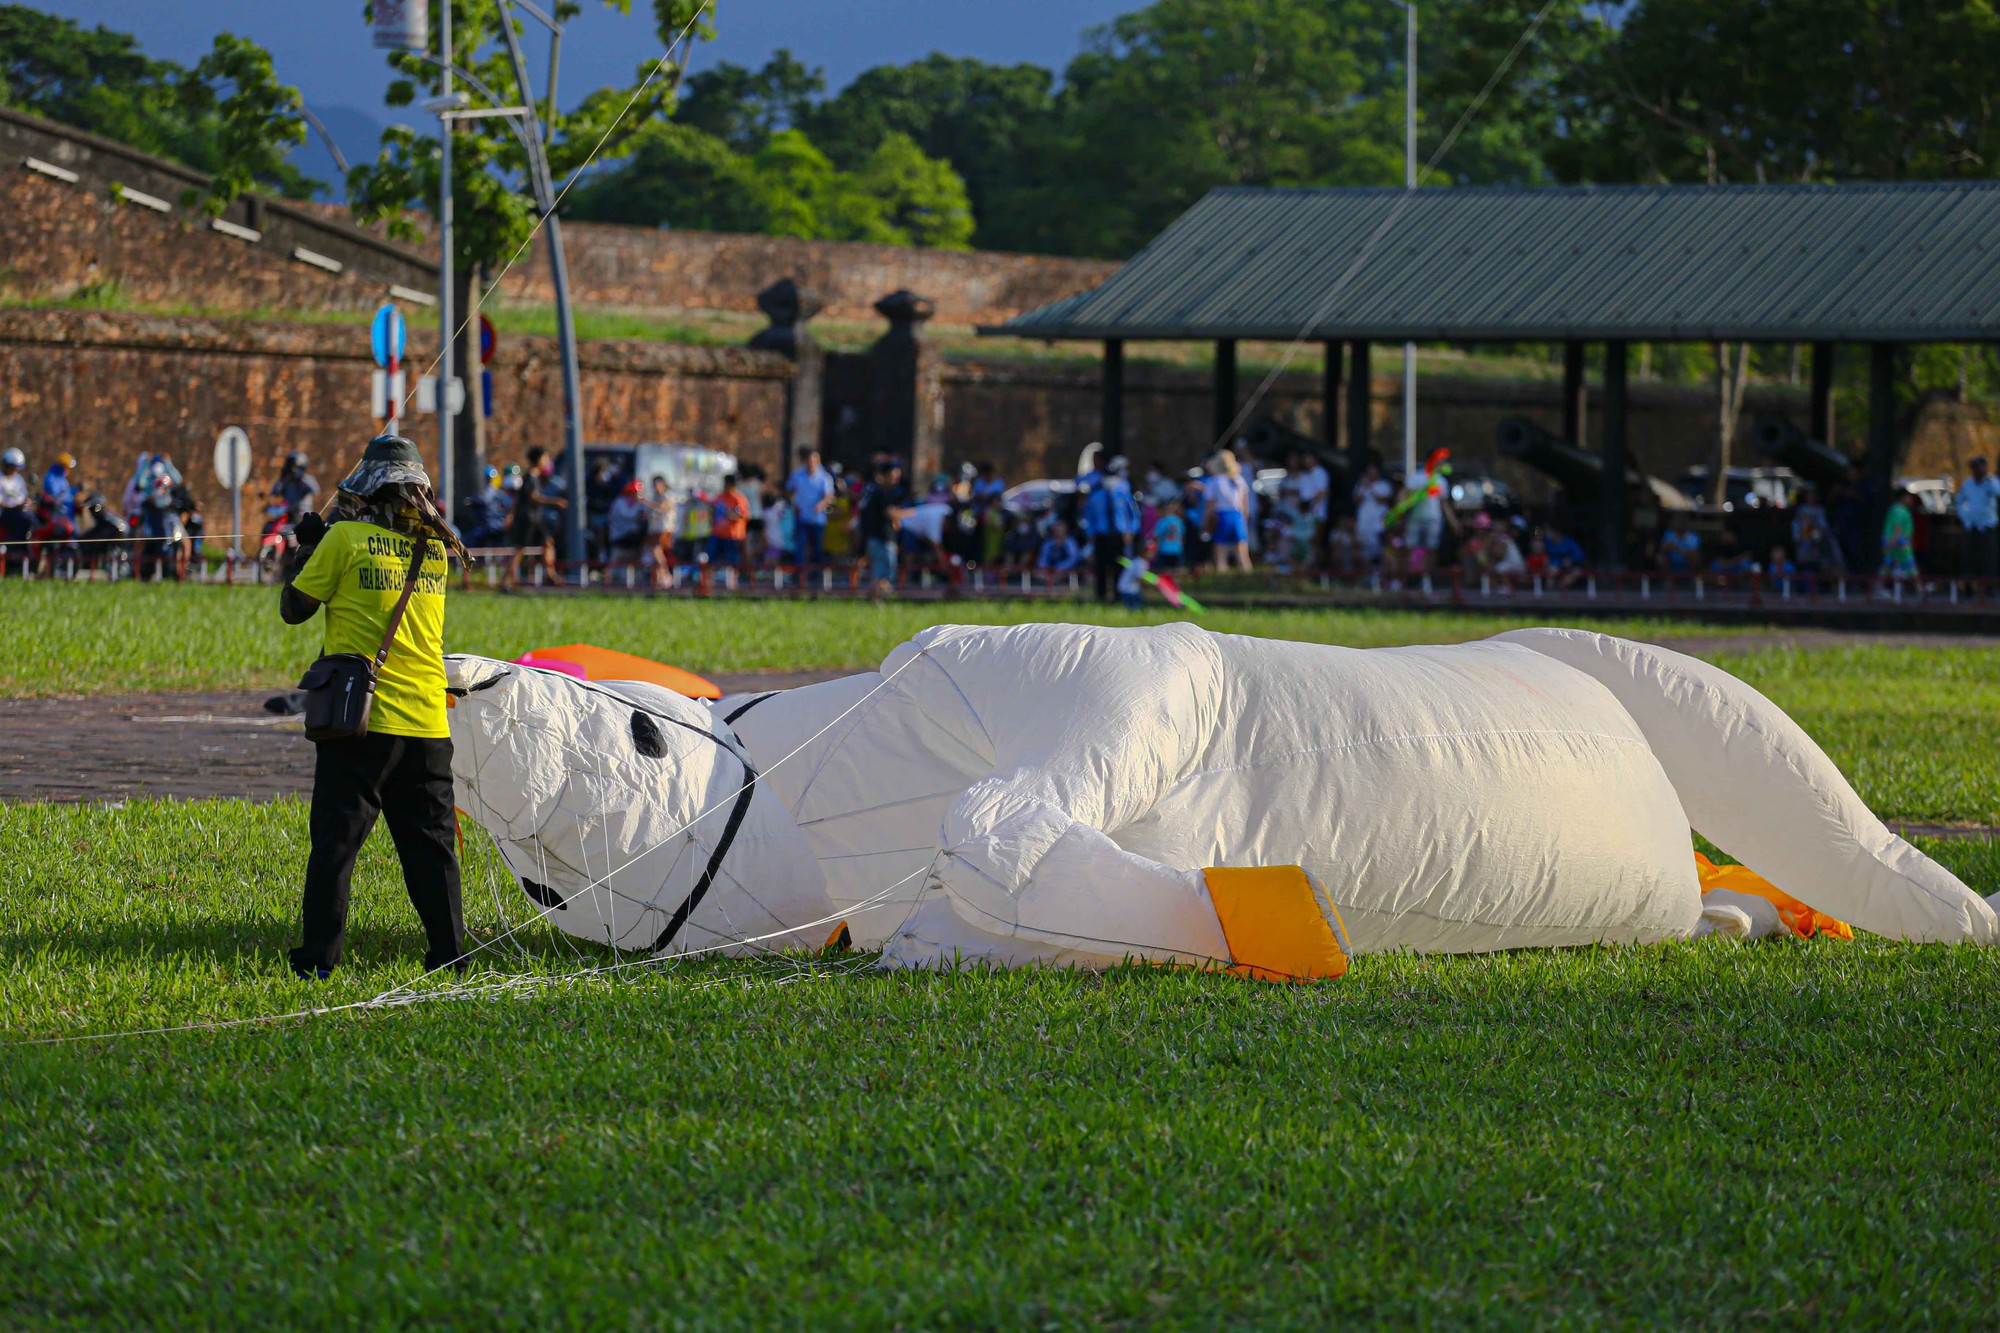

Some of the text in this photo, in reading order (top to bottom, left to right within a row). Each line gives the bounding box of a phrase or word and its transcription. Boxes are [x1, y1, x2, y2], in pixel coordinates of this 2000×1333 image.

[368, 533, 390, 556] CÂU
[393, 538, 409, 561] LẠC
[359, 562, 374, 590] NHÀ
[374, 562, 392, 591] HÀNG
